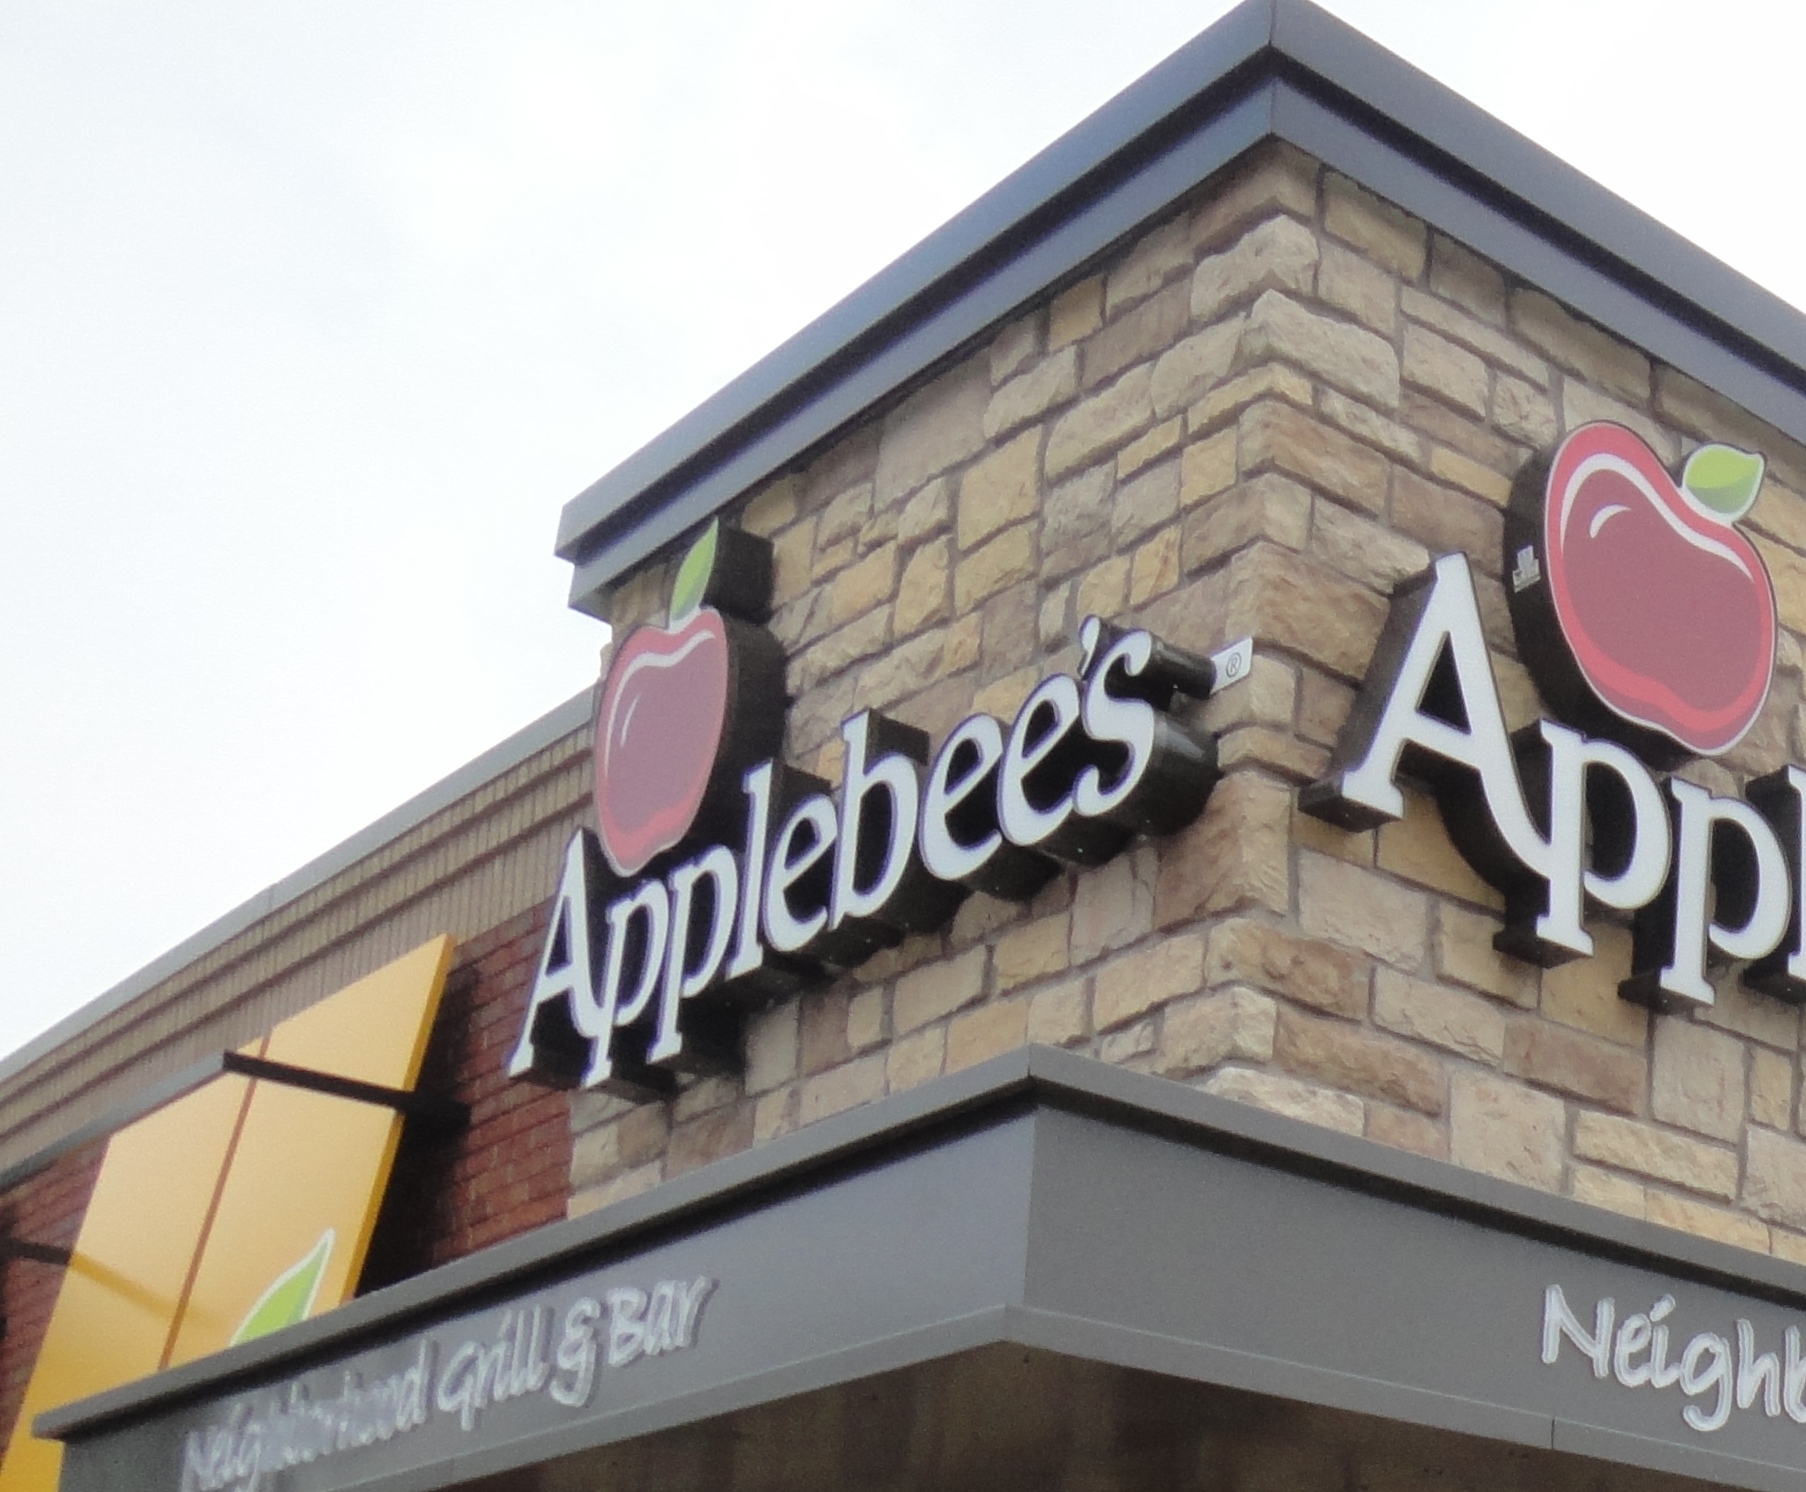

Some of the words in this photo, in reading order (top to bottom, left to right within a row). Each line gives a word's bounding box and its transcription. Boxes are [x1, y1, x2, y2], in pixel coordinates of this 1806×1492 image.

[508, 614, 1155, 1089] Applebee's
[437, 1303, 551, 1432] Grill
[551, 1295, 601, 1408] &
[607, 1274, 713, 1368] Bar
